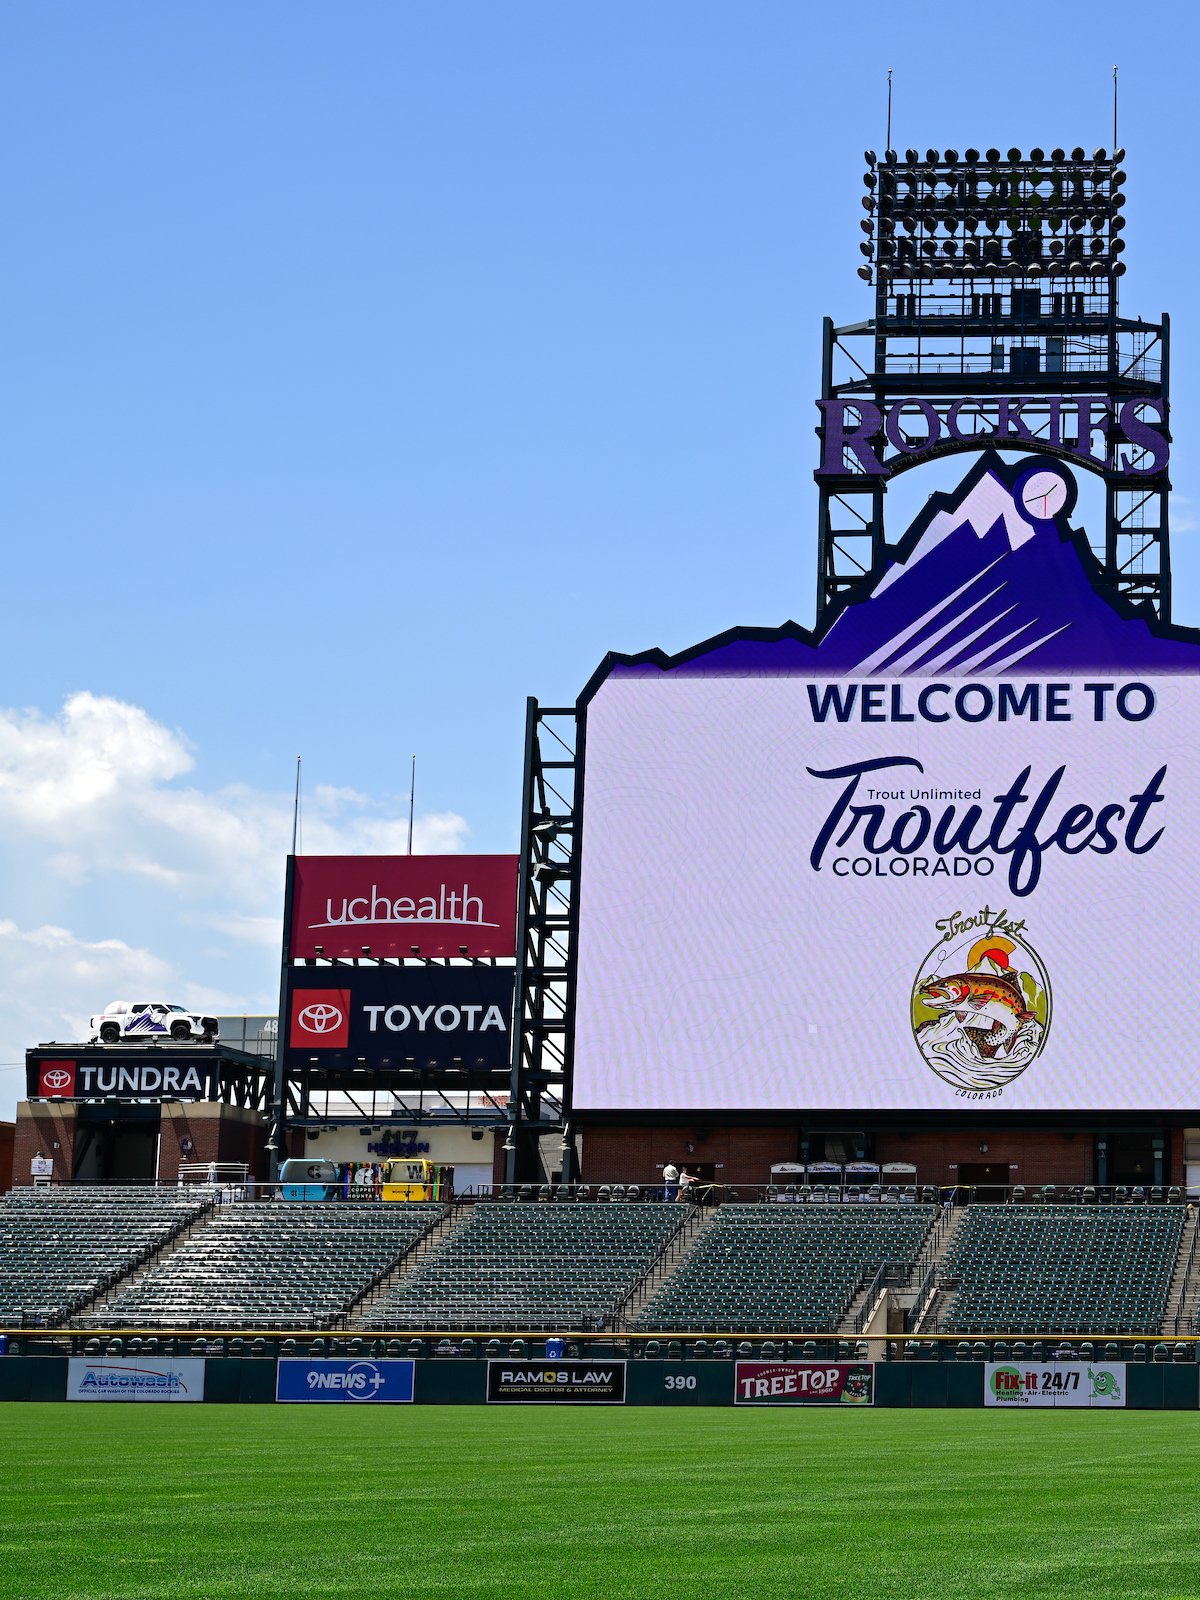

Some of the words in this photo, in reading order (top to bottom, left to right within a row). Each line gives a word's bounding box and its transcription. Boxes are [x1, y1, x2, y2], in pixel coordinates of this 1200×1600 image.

[814, 397, 1172, 477] ROCKIES
[806, 682, 1073, 723] WELCOME
[1084, 682, 1156, 722] TO
[867, 789, 906, 800] Trout
[910, 788, 982, 800] Unlimited
[805, 755, 1168, 897] Troutfest
[832, 856, 995, 878] COLORADO
[326, 884, 484, 925] uchealth
[936, 905, 1029, 942] Troutfest
[363, 1004, 507, 1032] TOYOTA
[80, 1066, 202, 1091] TUNDRA
[955, 1088, 1003, 1100] COLORADO
[80, 1372, 181, 1389] Autowash
[307, 1371, 367, 1389] 9NEWS
[501, 1371, 569, 1384] RAMOS
[572, 1371, 613, 1383] LAW
[664, 1375, 697, 1390] 390
[741, 1374, 798, 1399] TREE
[798, 1369, 840, 1391] TOP
[995, 1371, 1039, 1390] Fix-it
[1041, 1371, 1080, 1390] 24/7
